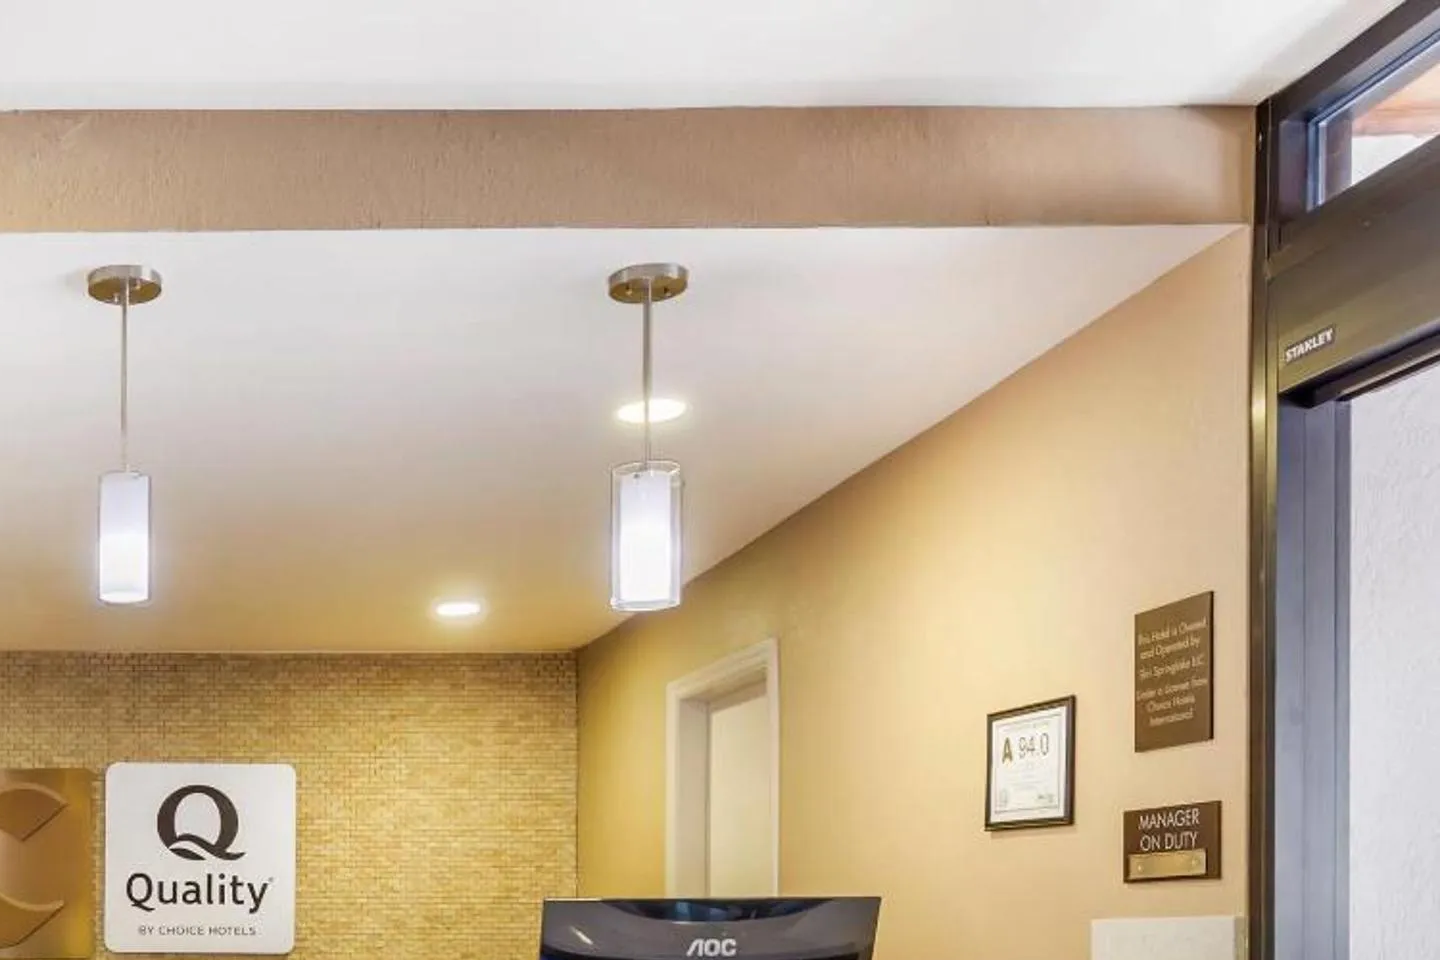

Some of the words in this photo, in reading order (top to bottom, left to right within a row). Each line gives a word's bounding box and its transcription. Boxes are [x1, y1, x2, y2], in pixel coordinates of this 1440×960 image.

[1286, 327, 1333, 363] STANLEY
[1002, 736, 1013, 764] A
[156, 784, 247, 861] Q
[1138, 808, 1200, 830] MANAGER
[1140, 834, 1161, 851] ON
[1164, 831, 1199, 849] DUTY
[126, 872, 269, 914] Quality
[138, 924, 155, 936] BY
[158, 924, 205, 936] CHOICE
[209, 924, 257, 936] HOTELS
[686, 938, 737, 957] AOC
